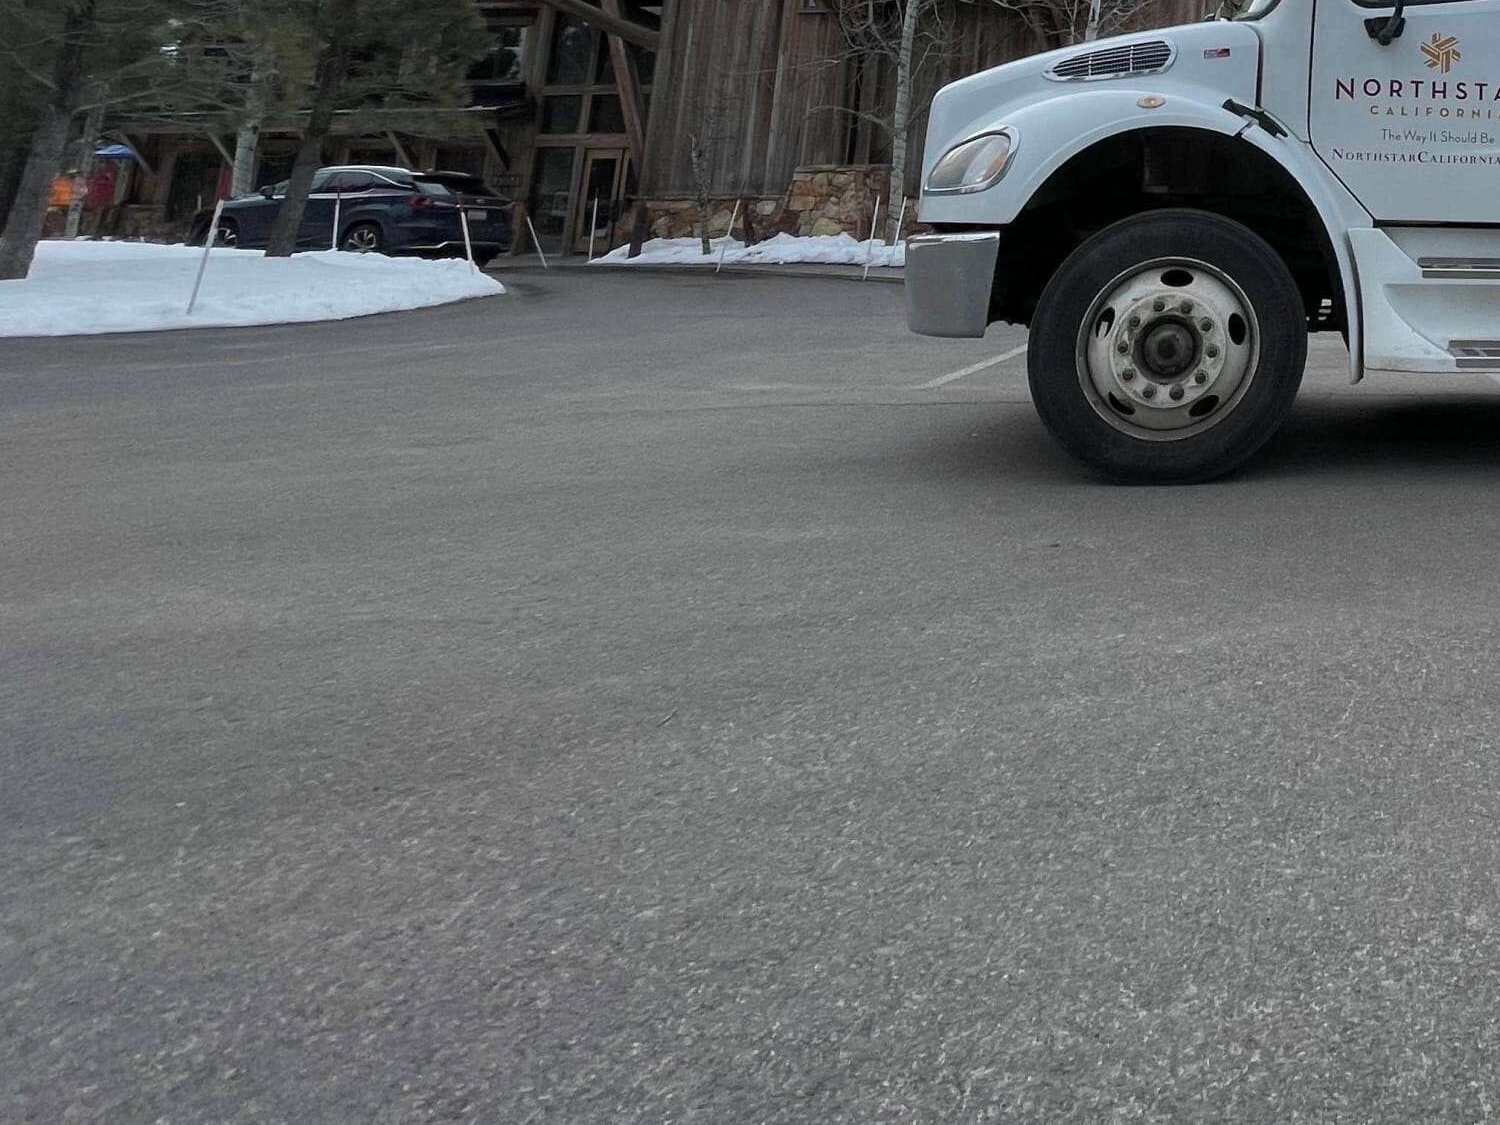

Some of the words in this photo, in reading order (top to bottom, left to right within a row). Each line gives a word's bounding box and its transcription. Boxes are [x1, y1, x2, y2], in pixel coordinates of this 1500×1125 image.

[1381, 128, 1401, 141] The
[1403, 130, 1427, 144] Way
[1440, 131, 1477, 143] Should
[1481, 132, 1495, 144] Be
